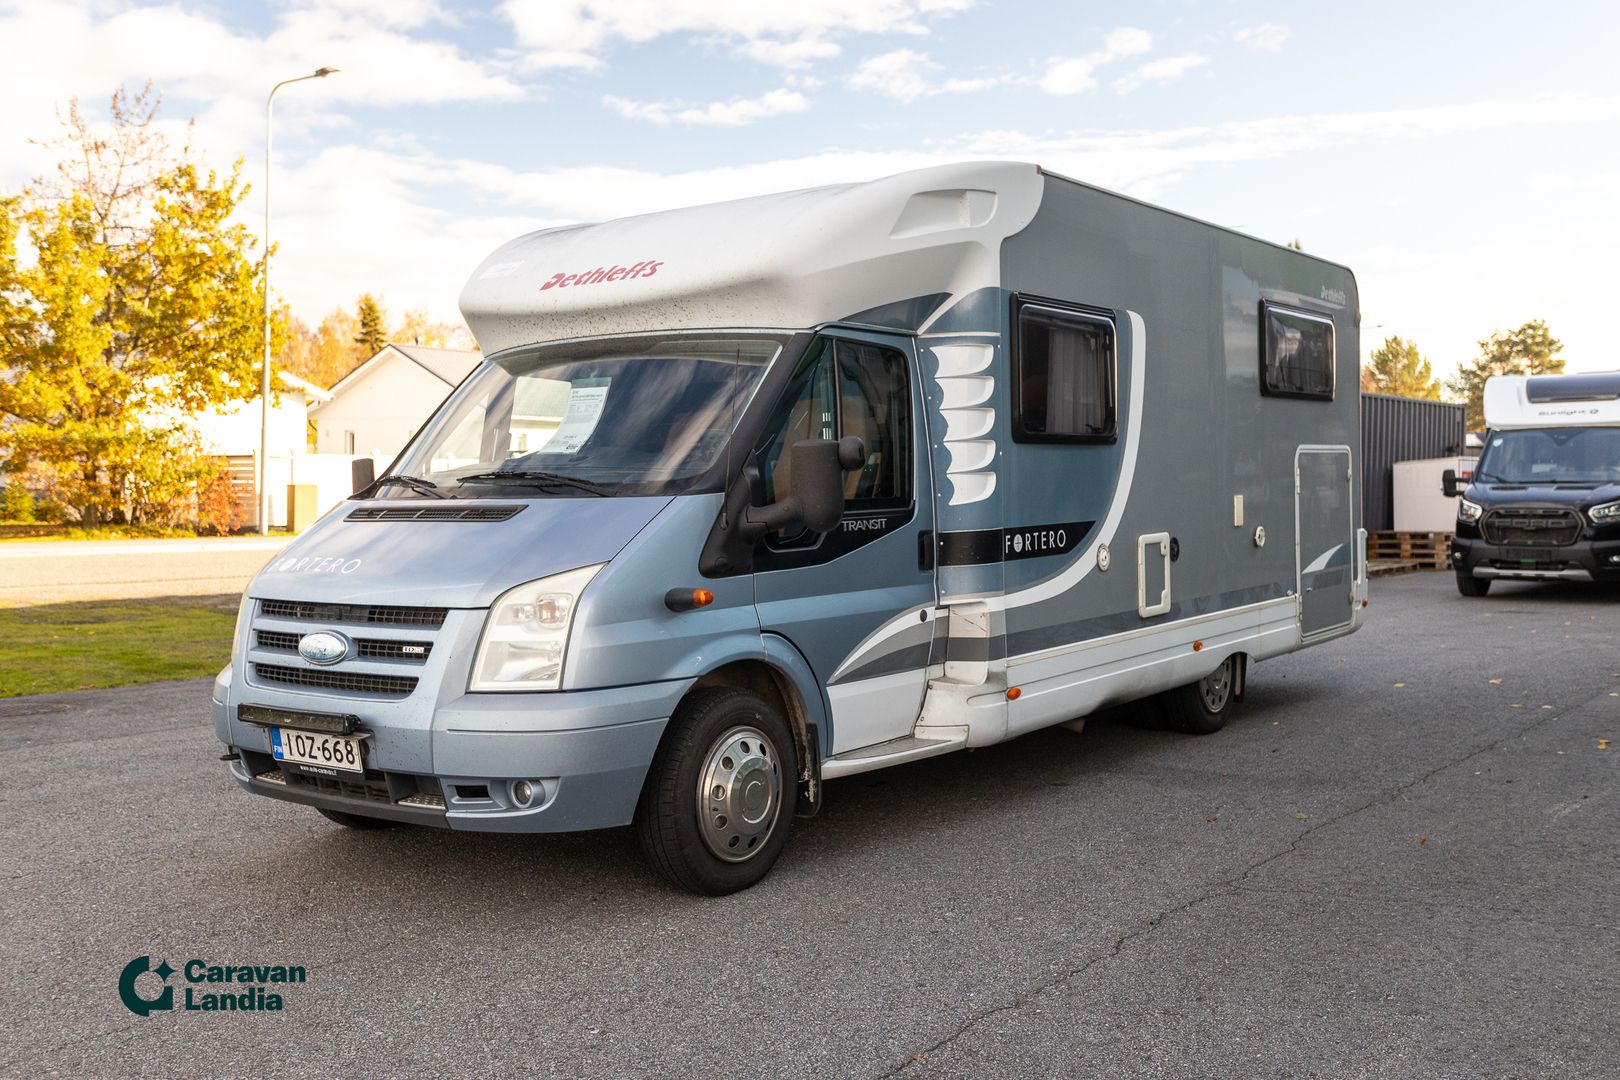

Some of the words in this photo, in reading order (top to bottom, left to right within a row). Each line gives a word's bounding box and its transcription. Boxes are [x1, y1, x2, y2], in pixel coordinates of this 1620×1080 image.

[539, 260, 665, 290] Dethleffs
[841, 518, 887, 532] TRANSIT
[1495, 519, 1566, 528] FORD
[1005, 529, 1067, 554] FORTERO
[287, 733, 356, 765] IOZ-668
